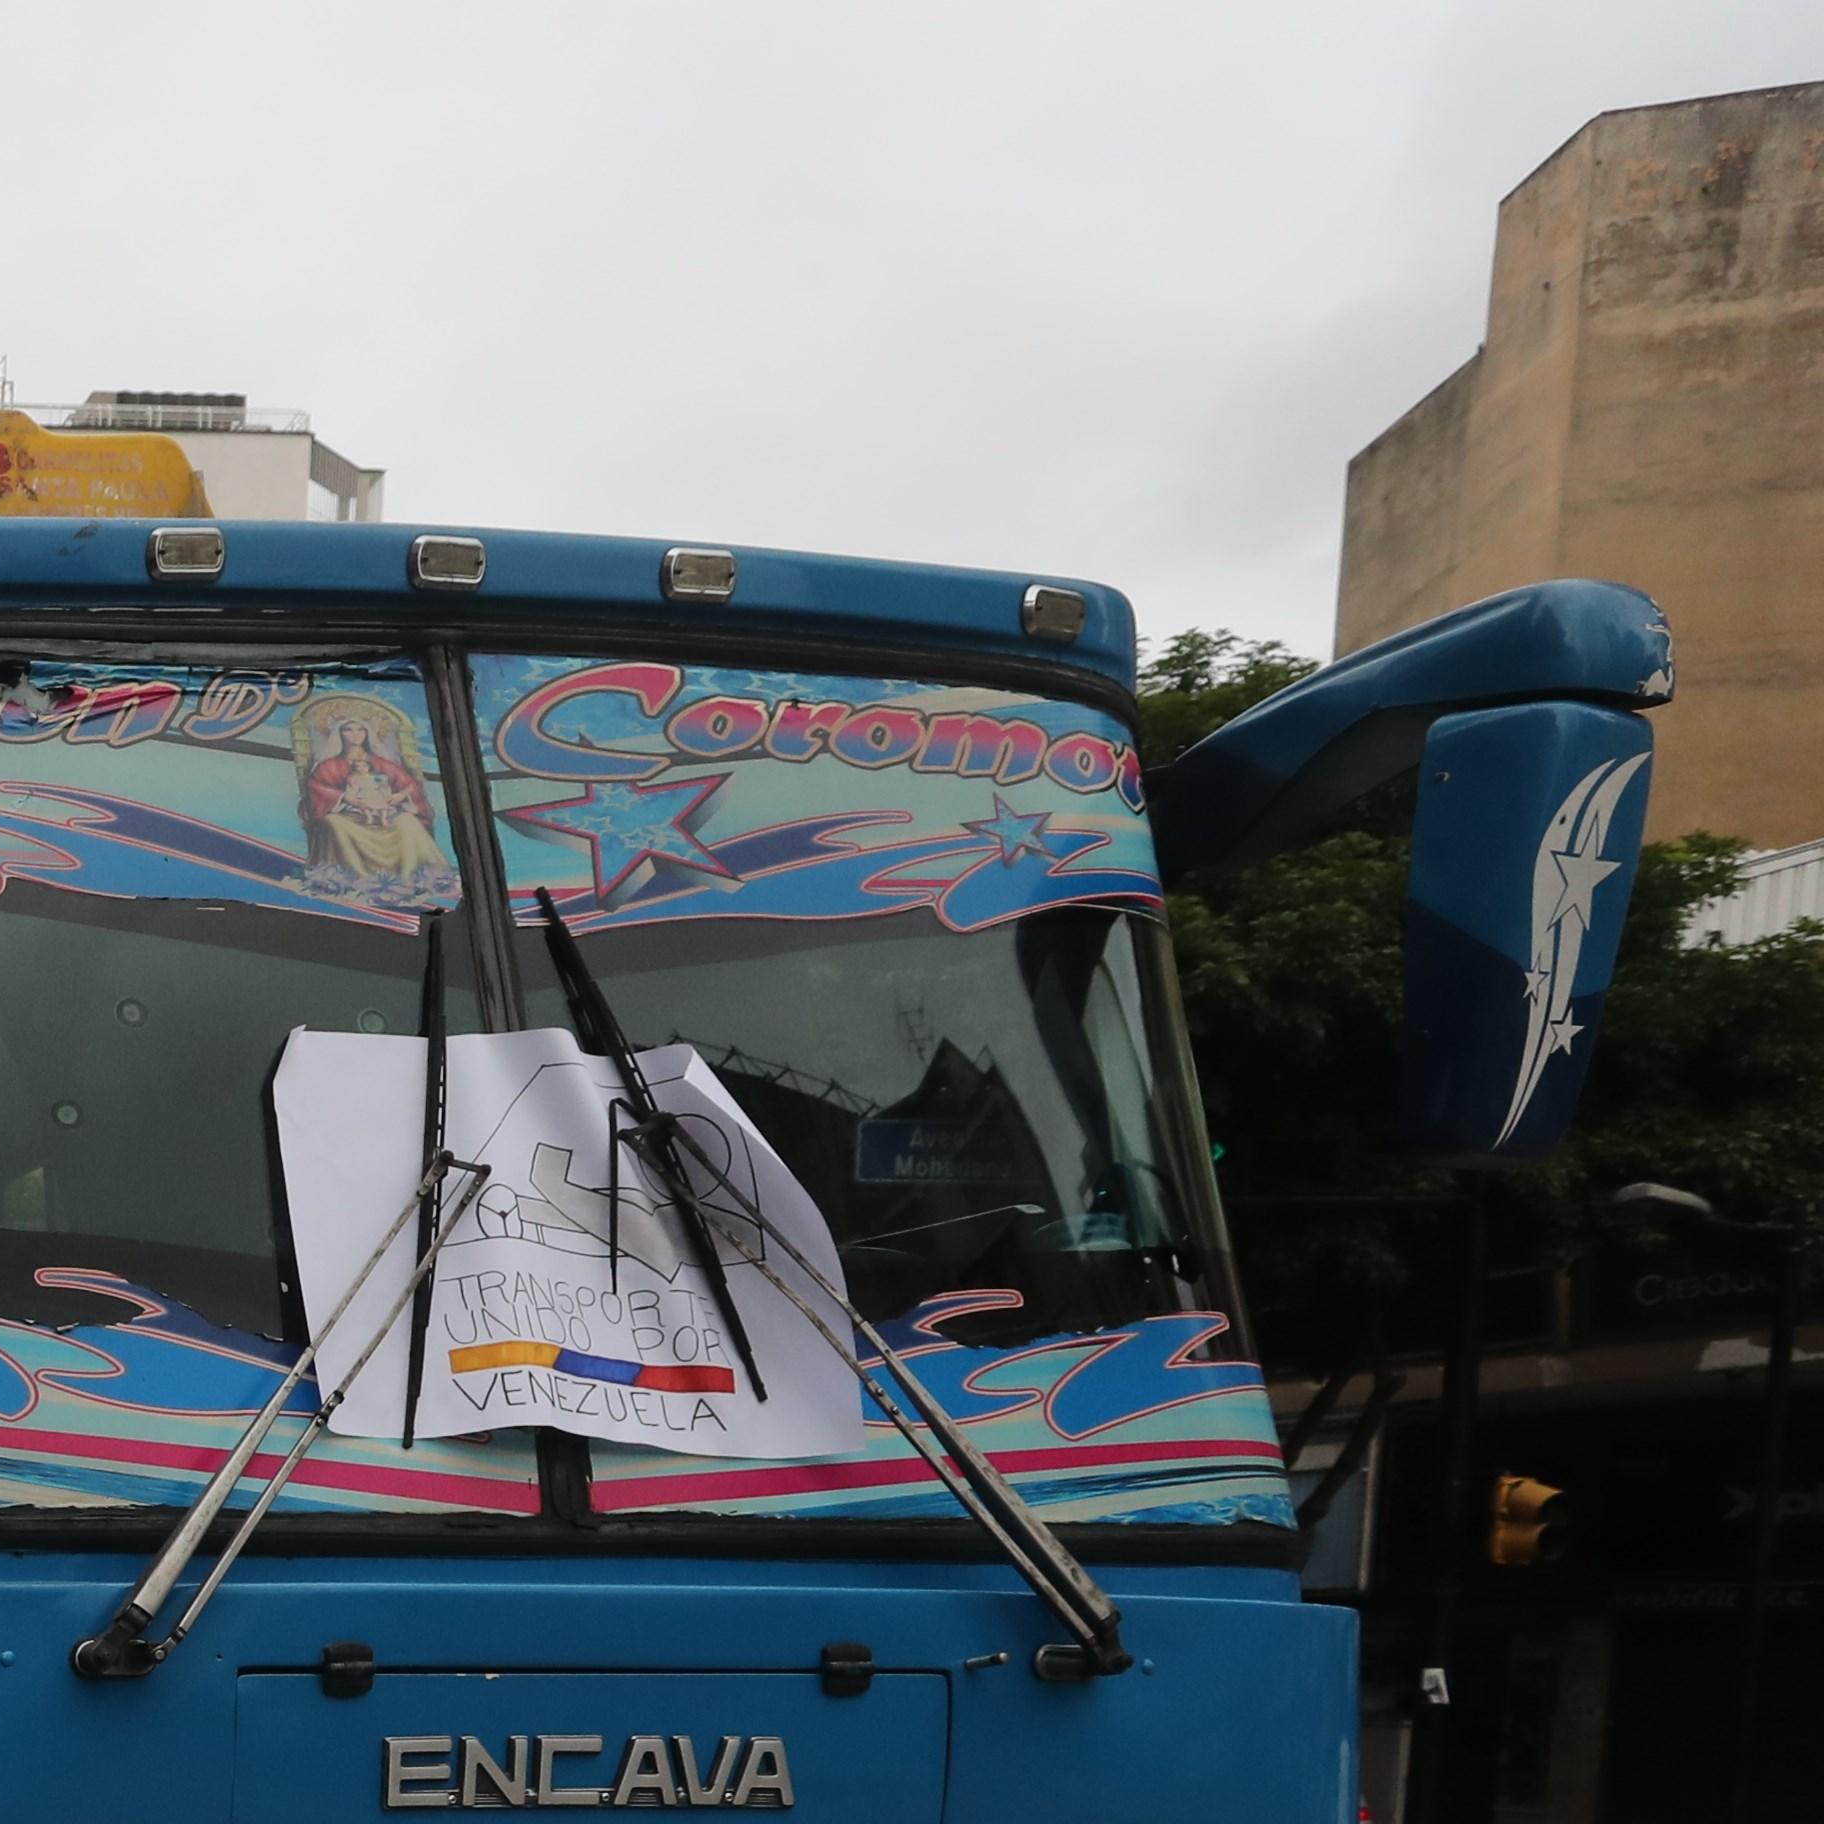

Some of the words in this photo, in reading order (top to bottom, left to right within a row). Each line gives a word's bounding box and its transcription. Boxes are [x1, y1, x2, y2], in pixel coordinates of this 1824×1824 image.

[443, 1303, 593, 1353] UNIDO
[631, 1325, 728, 1366] POR
[453, 1369, 728, 1432] VENEZUELA
[383, 1734, 795, 1808] ENCAVA
